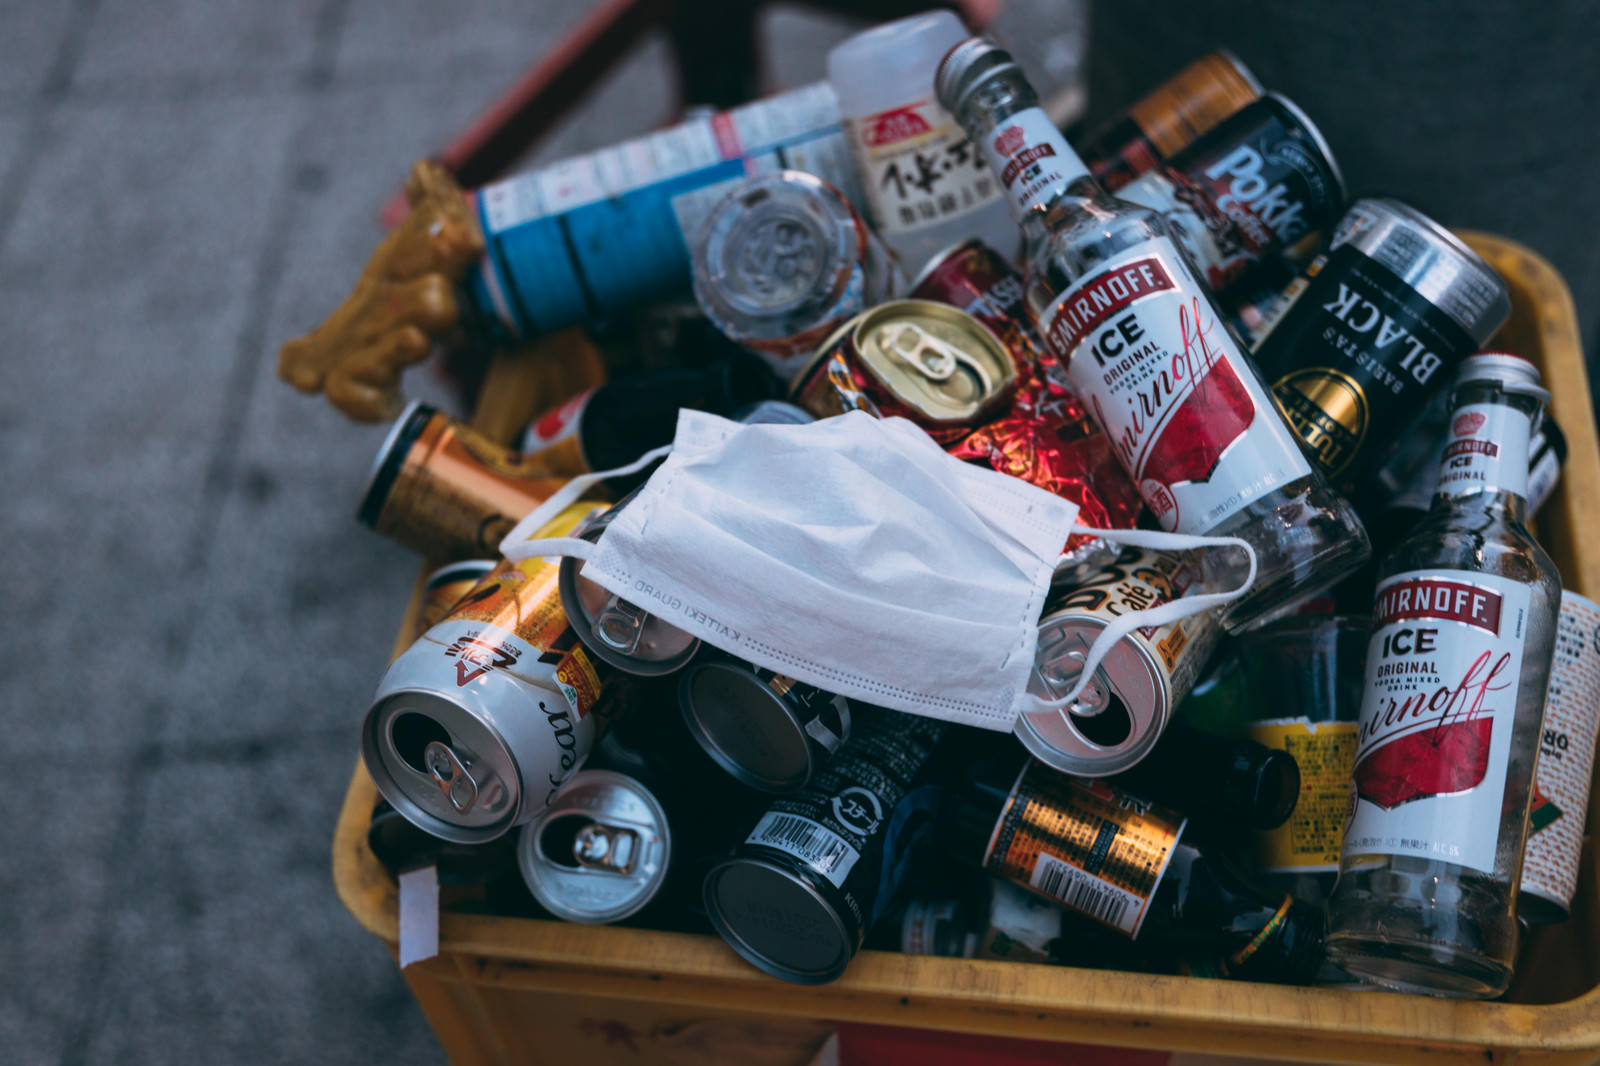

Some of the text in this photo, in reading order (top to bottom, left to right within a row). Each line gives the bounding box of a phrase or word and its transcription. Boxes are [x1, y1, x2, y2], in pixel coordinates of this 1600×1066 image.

[1021, 164, 1041, 185] ICE
[1091, 313, 1145, 368] ICE
[1323, 282, 1443, 385] BLACK
[1103, 340, 1160, 387] ORIGINAL
[1322, 326, 1405, 395] BARISTA'S
[1382, 628, 1438, 659] ICE
[1377, 661, 1438, 678] ORIGINAL
